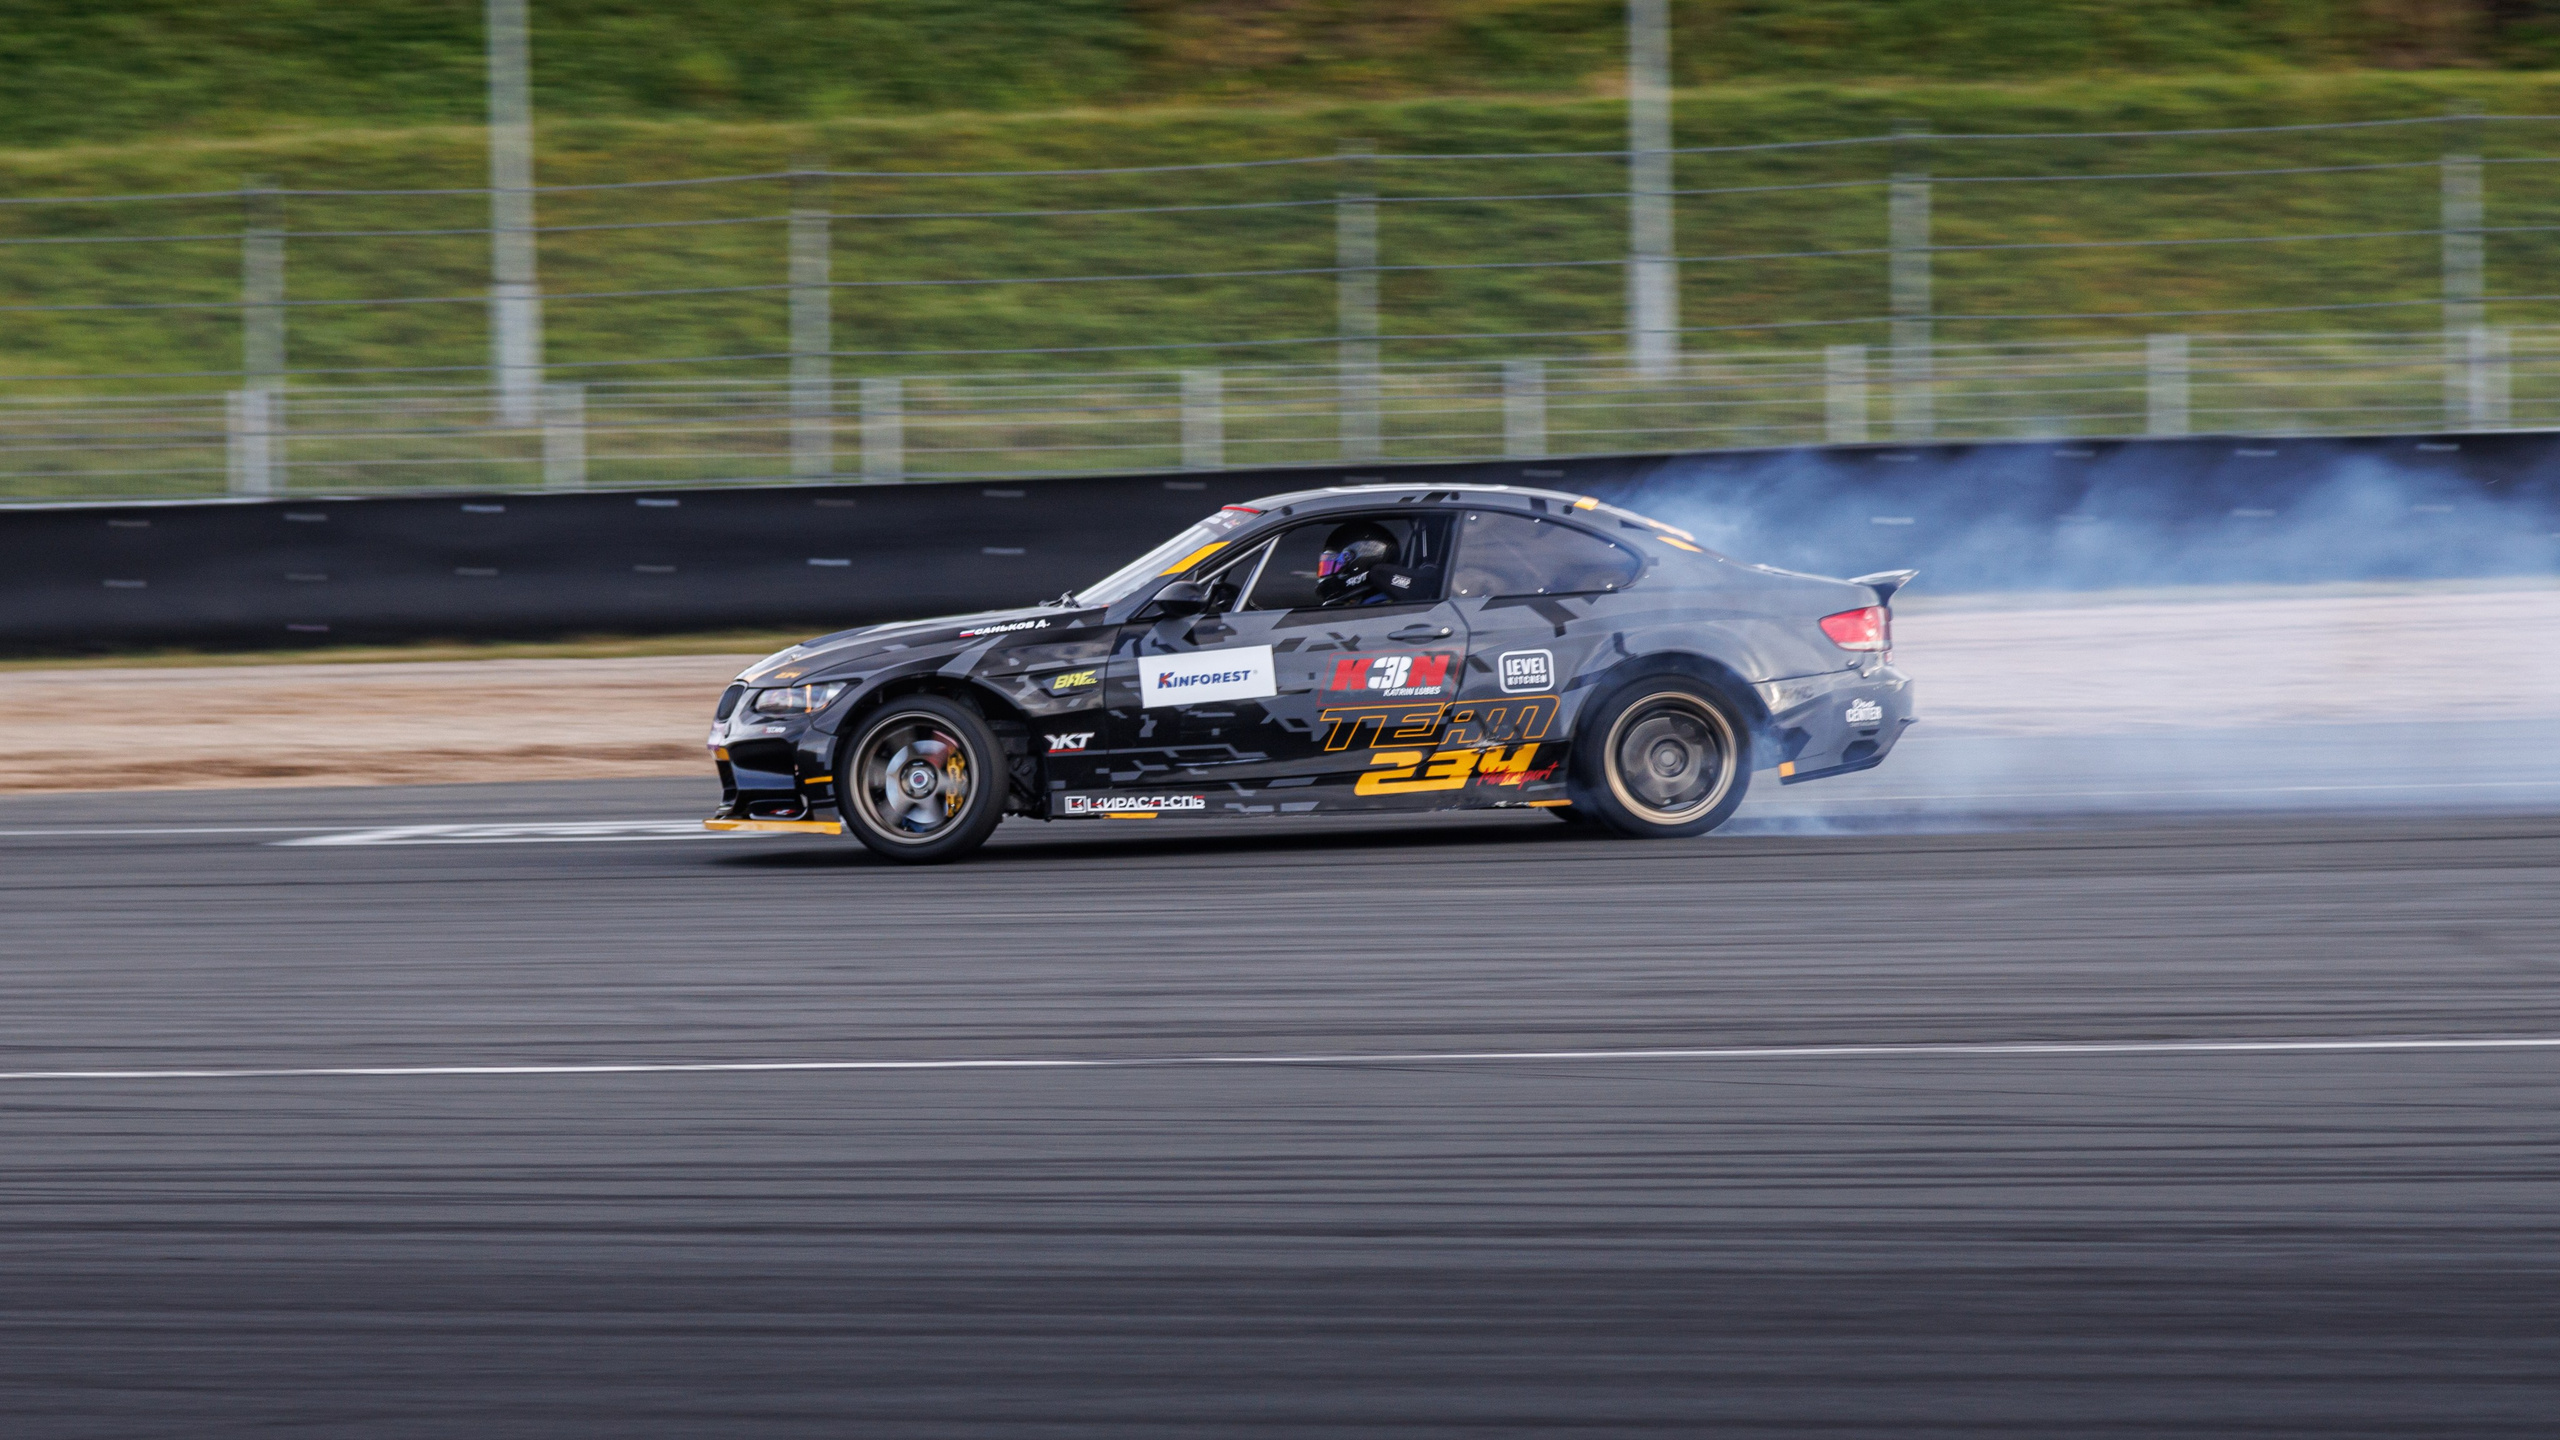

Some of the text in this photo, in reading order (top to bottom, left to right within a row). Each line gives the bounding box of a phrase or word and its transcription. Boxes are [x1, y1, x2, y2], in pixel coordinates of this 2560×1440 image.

[974, 620, 1035, 635] САНЬКОВ
[1506, 657, 1547, 675] LEVEL
[1157, 669, 1251, 689] KINFOREST
[1507, 674, 1548, 685] KITCHEN
[1414, 686, 1441, 695] LUBES
[1319, 694, 1561, 752] TEAM
[1354, 742, 1541, 797] 234
[1476, 760, 1560, 790] Motorsport
